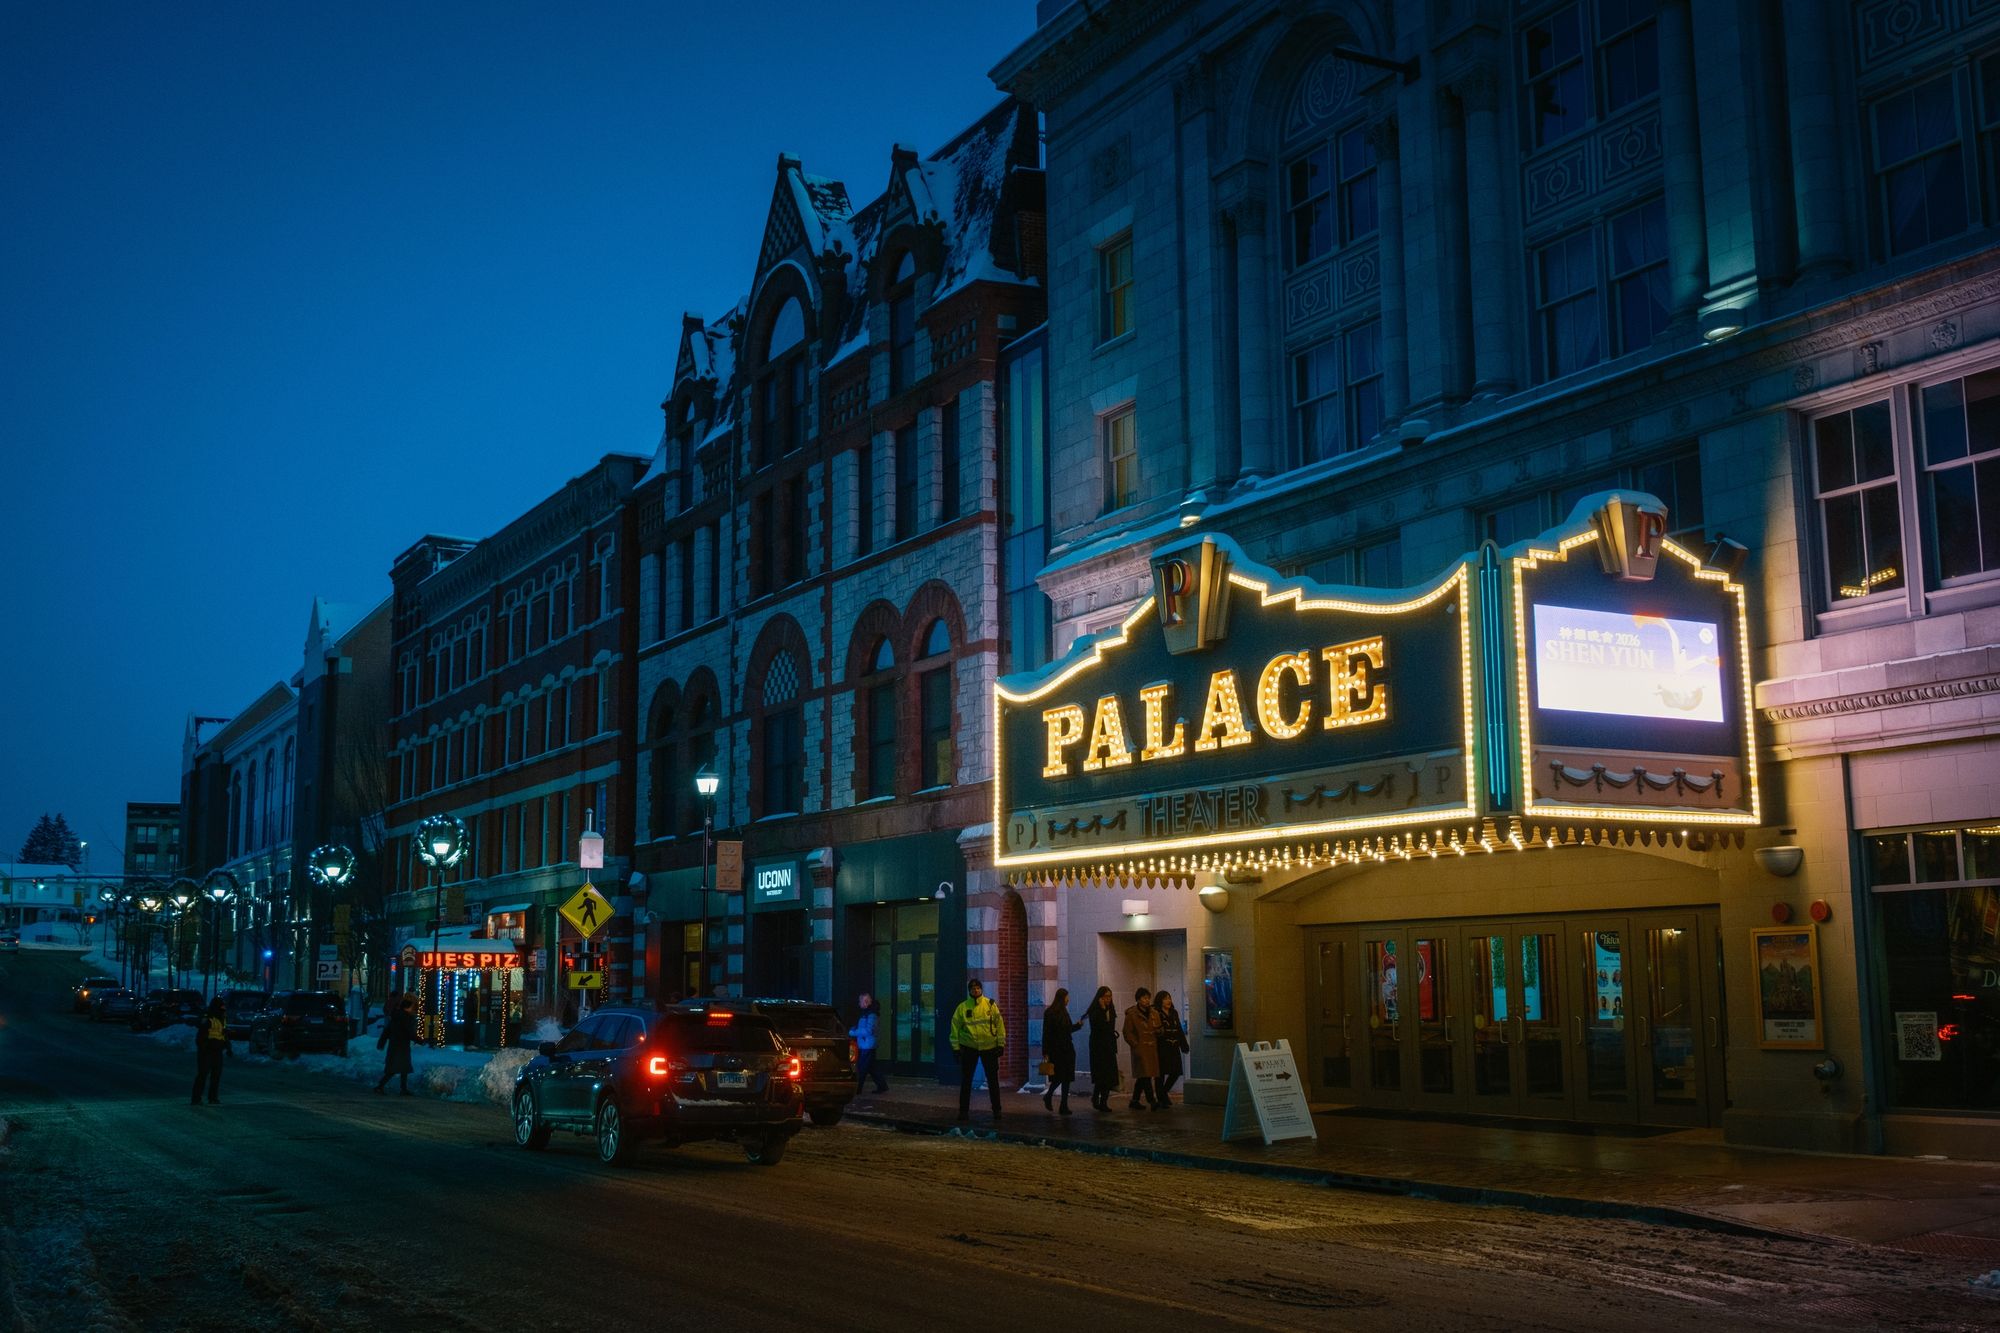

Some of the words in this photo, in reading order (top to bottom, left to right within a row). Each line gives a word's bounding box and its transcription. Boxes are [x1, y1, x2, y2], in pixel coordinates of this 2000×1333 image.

[1159, 558, 1193, 628] P
[1545, 639, 1605, 665] SHEN
[1608, 645, 1657, 670] YUN
[1615, 632, 1641, 647] 2026
[1042, 635, 1389, 778] PALACE
[1136, 784, 1264, 837] THEATER
[758, 868, 791, 890] UCONN
